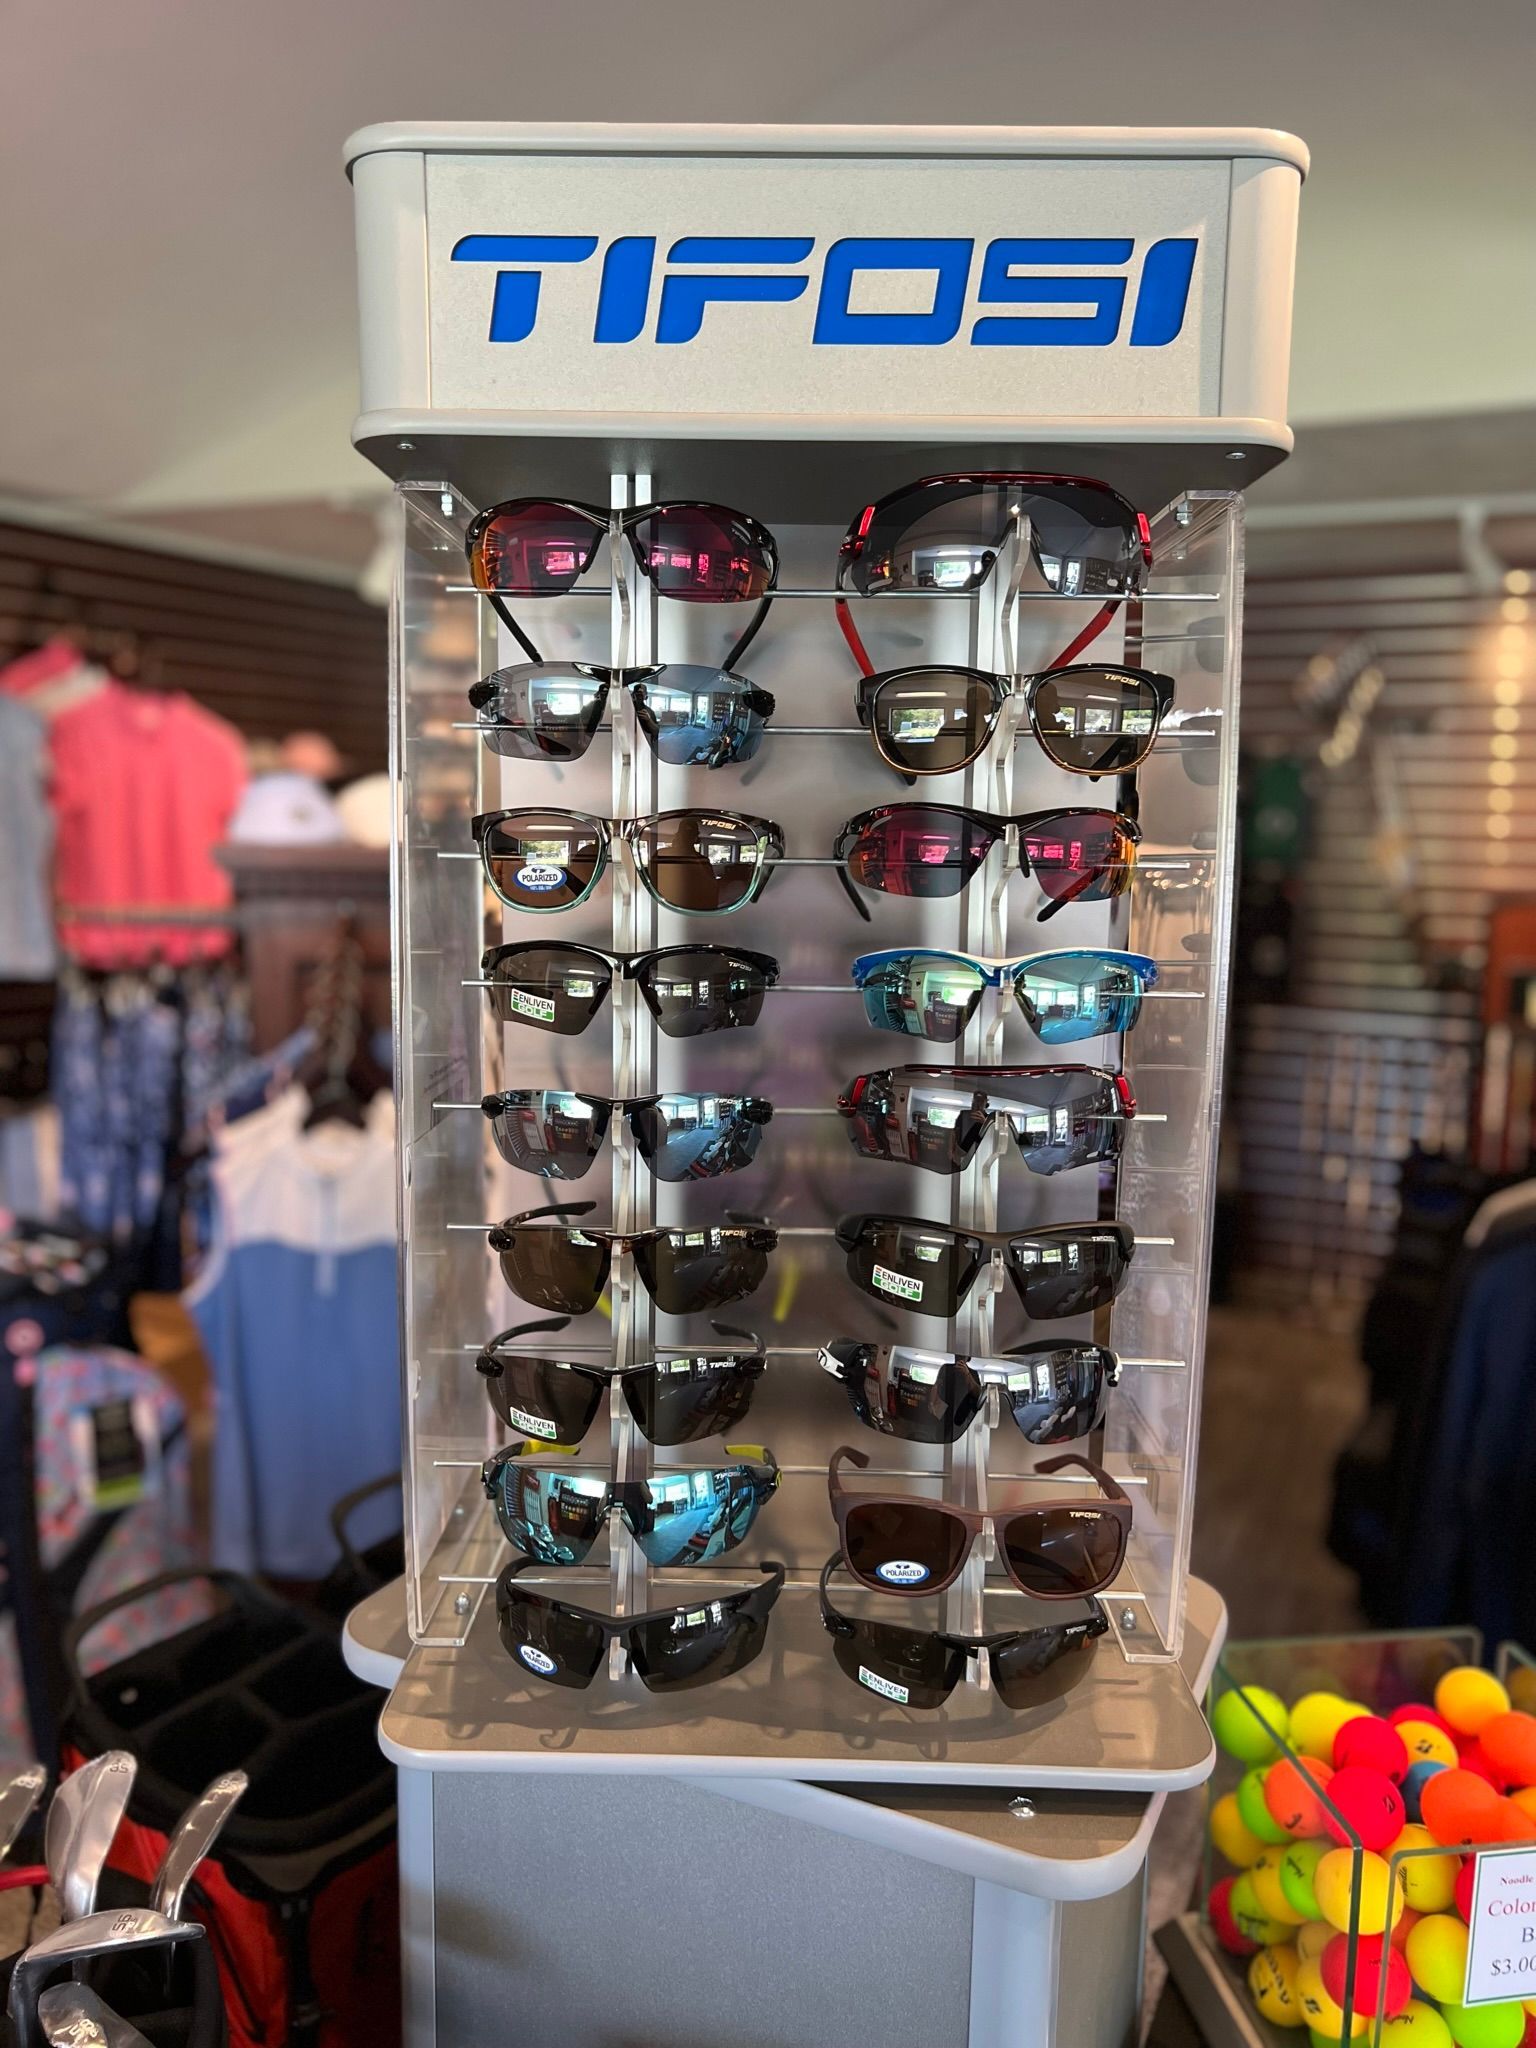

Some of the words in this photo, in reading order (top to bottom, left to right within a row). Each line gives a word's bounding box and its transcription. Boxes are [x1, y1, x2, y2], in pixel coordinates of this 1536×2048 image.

[451, 235, 1199, 345] TIFOSI
[1104, 673, 1140, 687] TIFOSI
[701, 818, 737, 831] TIFOSI
[521, 873, 558, 883] POLARIZED
[728, 960, 752, 972] TIFOSI
[1103, 965, 1129, 976] TIFOSI
[518, 993, 554, 1011] ENLIVEN
[518, 1003, 547, 1018] GOLF
[882, 1271, 920, 1291] ENLIVEN
[880, 1281, 913, 1299] GOLF
[709, 1361, 737, 1369] TIFOSI
[518, 1413, 554, 1431] ENLIVEN
[1070, 1511, 1101, 1520] TIFOSI
[886, 1569, 922, 1578] POLARIZED
[868, 1674, 907, 1696] ENLIVEN
[1501, 1874, 1534, 1885] Noodle
